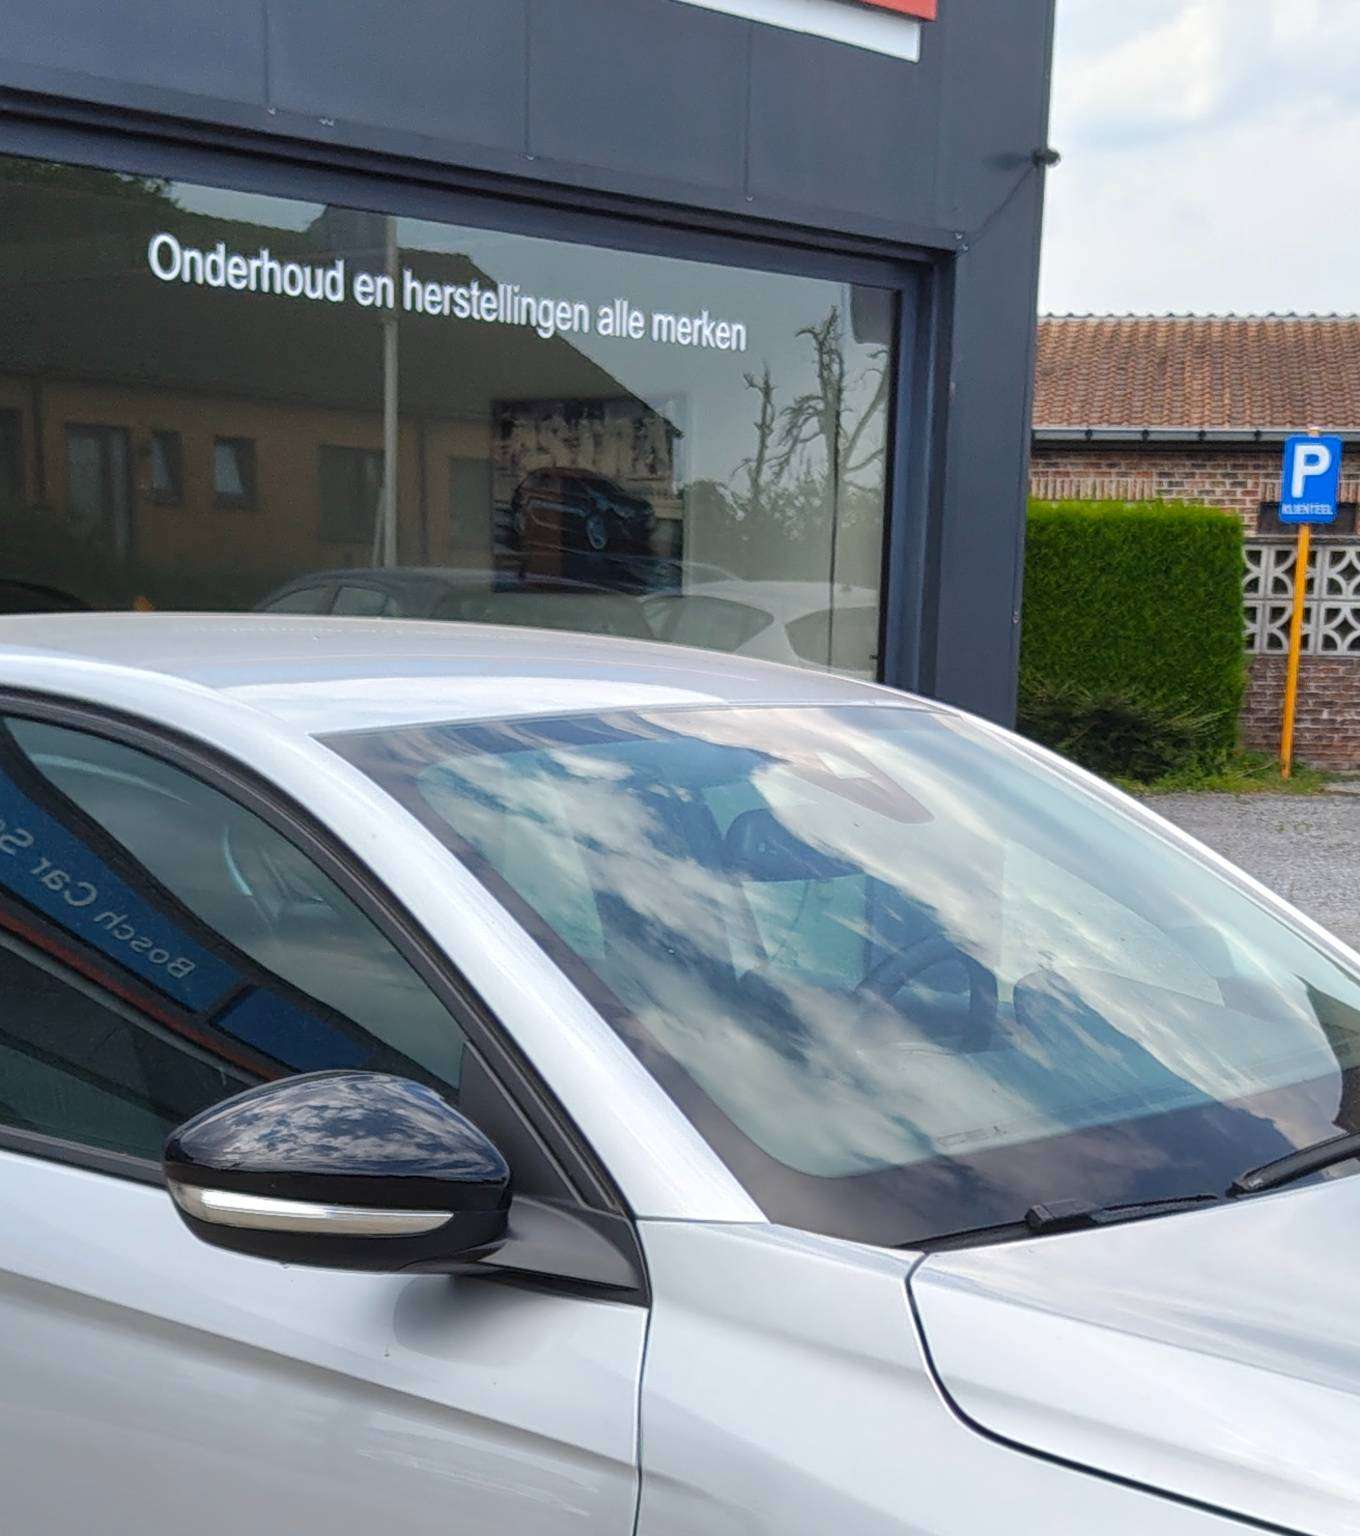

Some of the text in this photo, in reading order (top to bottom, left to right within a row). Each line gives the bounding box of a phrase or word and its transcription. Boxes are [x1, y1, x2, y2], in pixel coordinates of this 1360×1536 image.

[148, 233, 747, 352] Onderhoud en herstellingen alle merken
[1291, 443, 1332, 498] P
